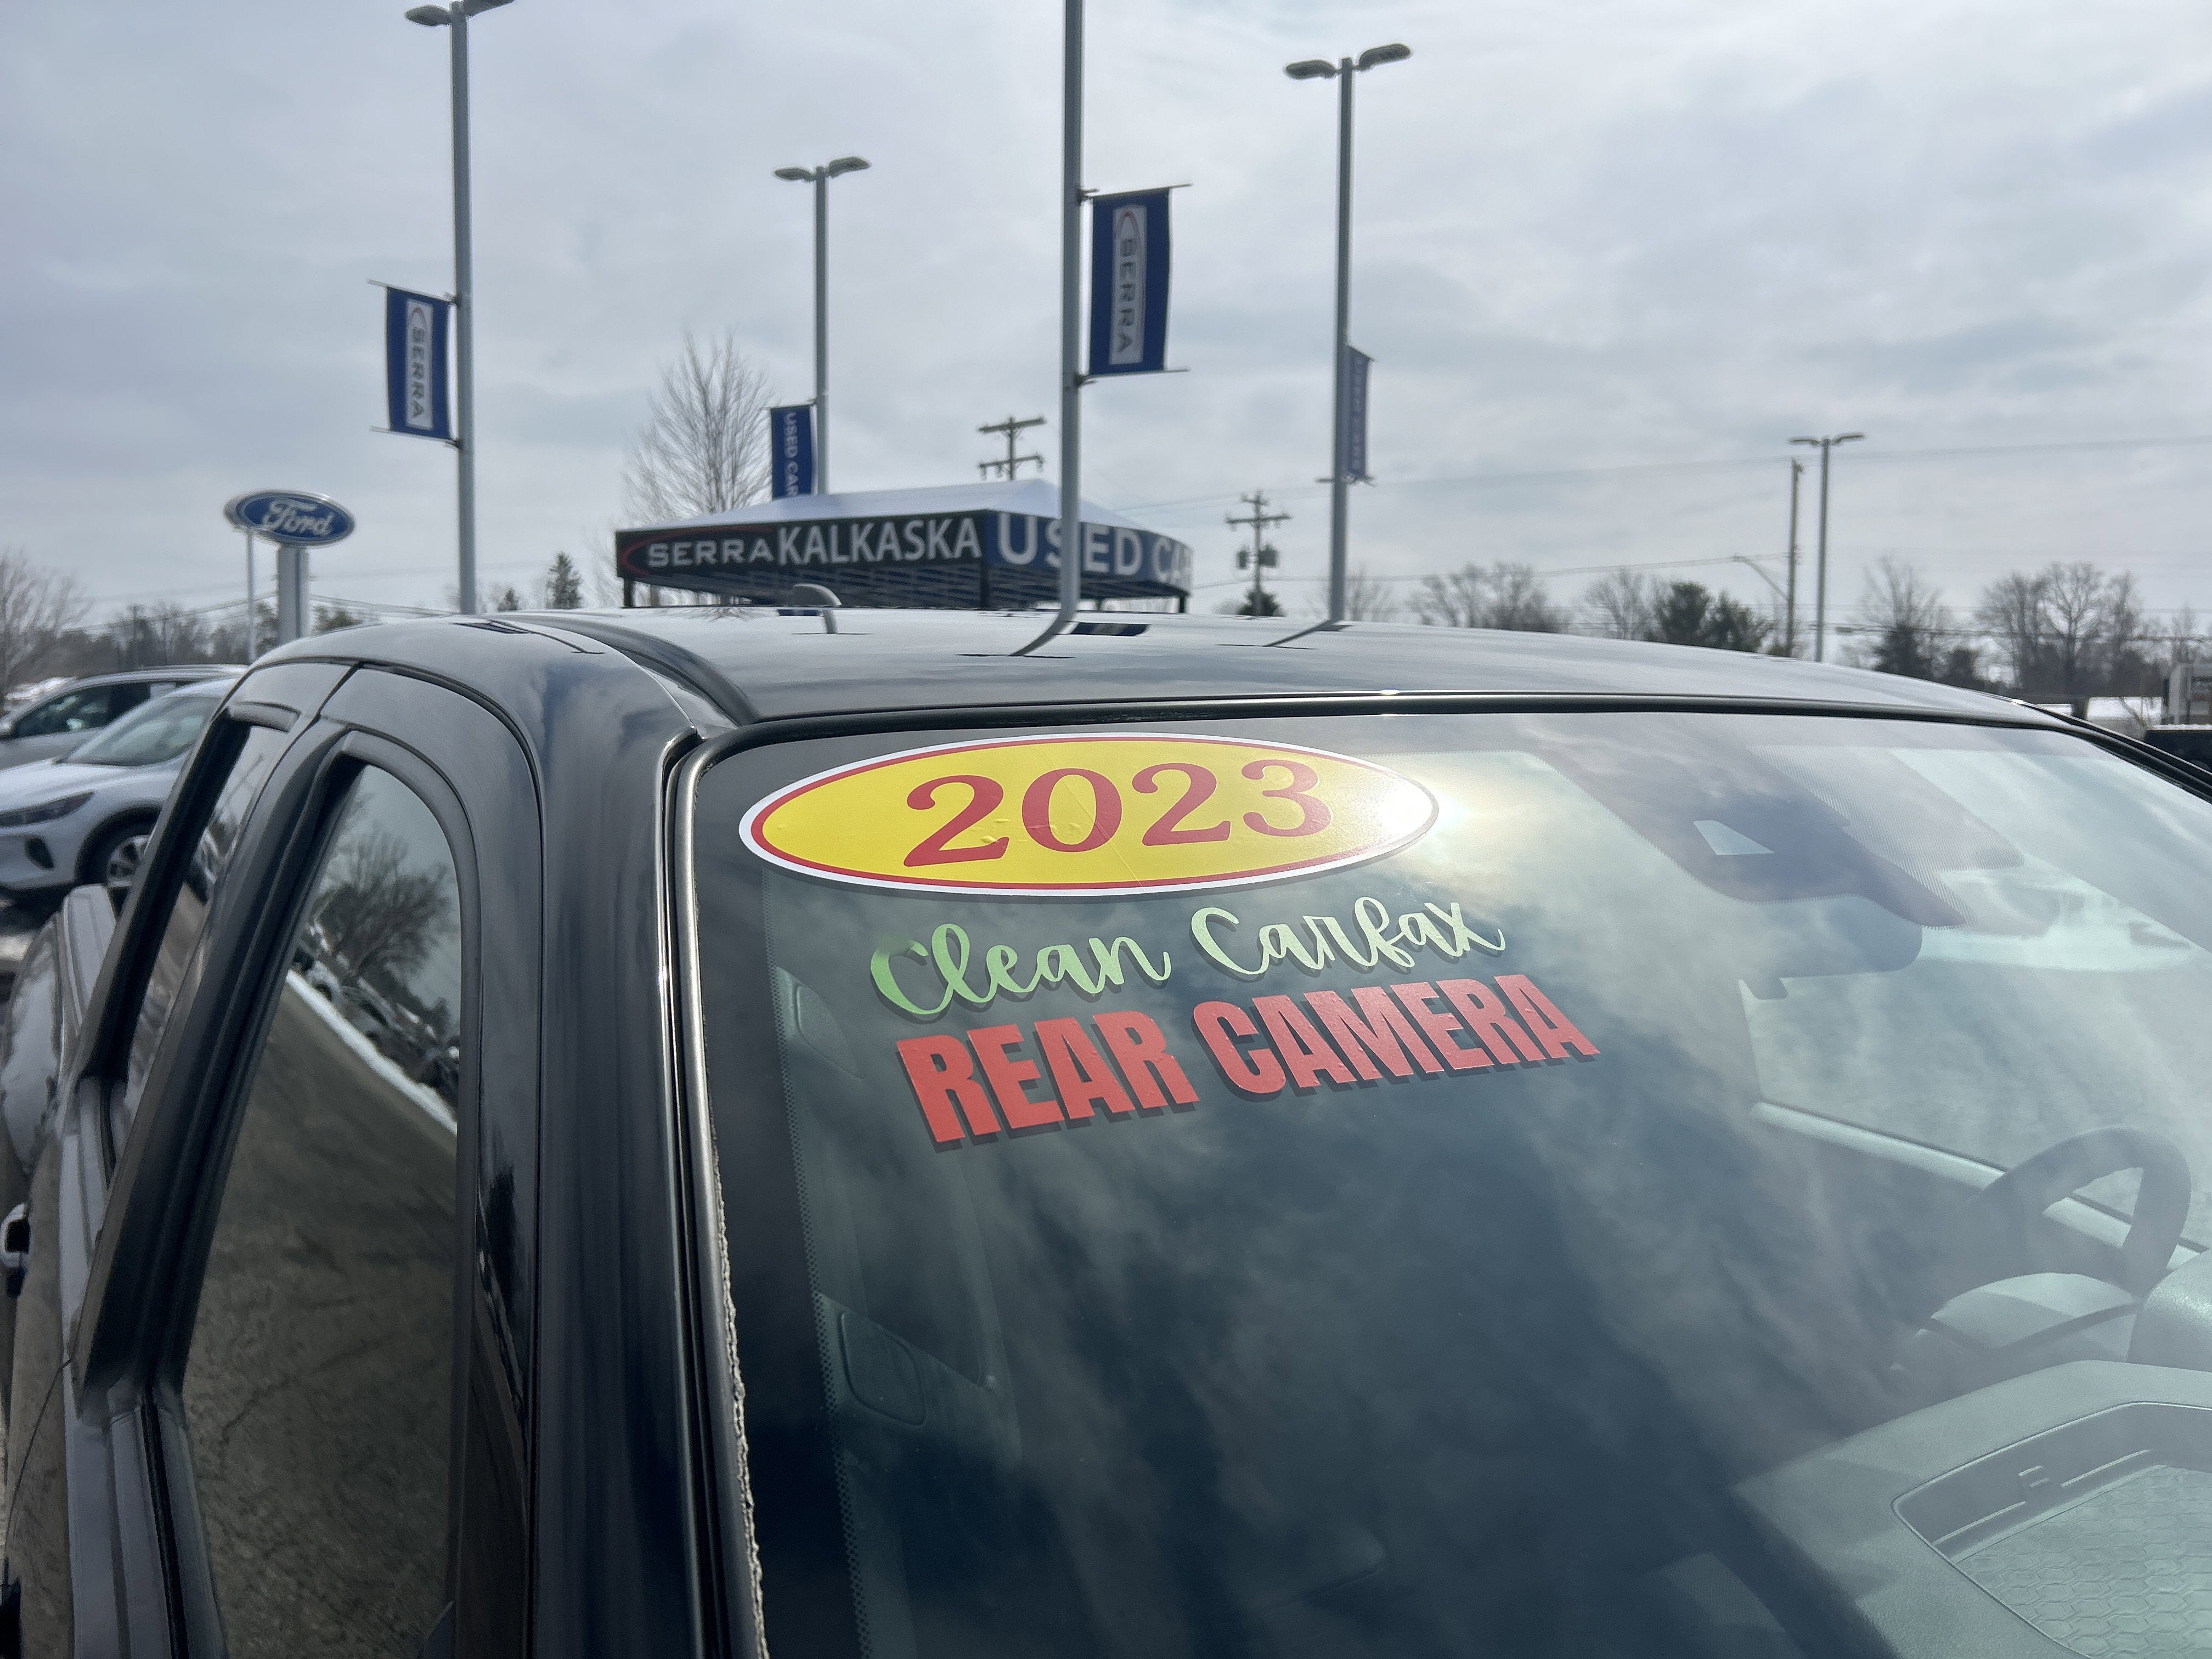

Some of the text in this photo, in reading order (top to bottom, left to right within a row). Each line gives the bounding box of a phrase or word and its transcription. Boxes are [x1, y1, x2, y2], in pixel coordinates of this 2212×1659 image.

[783, 411, 798, 459] USED
[262, 498, 335, 536] Ford
[647, 517, 982, 568] SERRA KALKASKA
[903, 759, 1332, 867] 2023
[870, 896, 1506, 1015] Clean Carfax
[895, 974, 1601, 1143] REAR CAMERA
